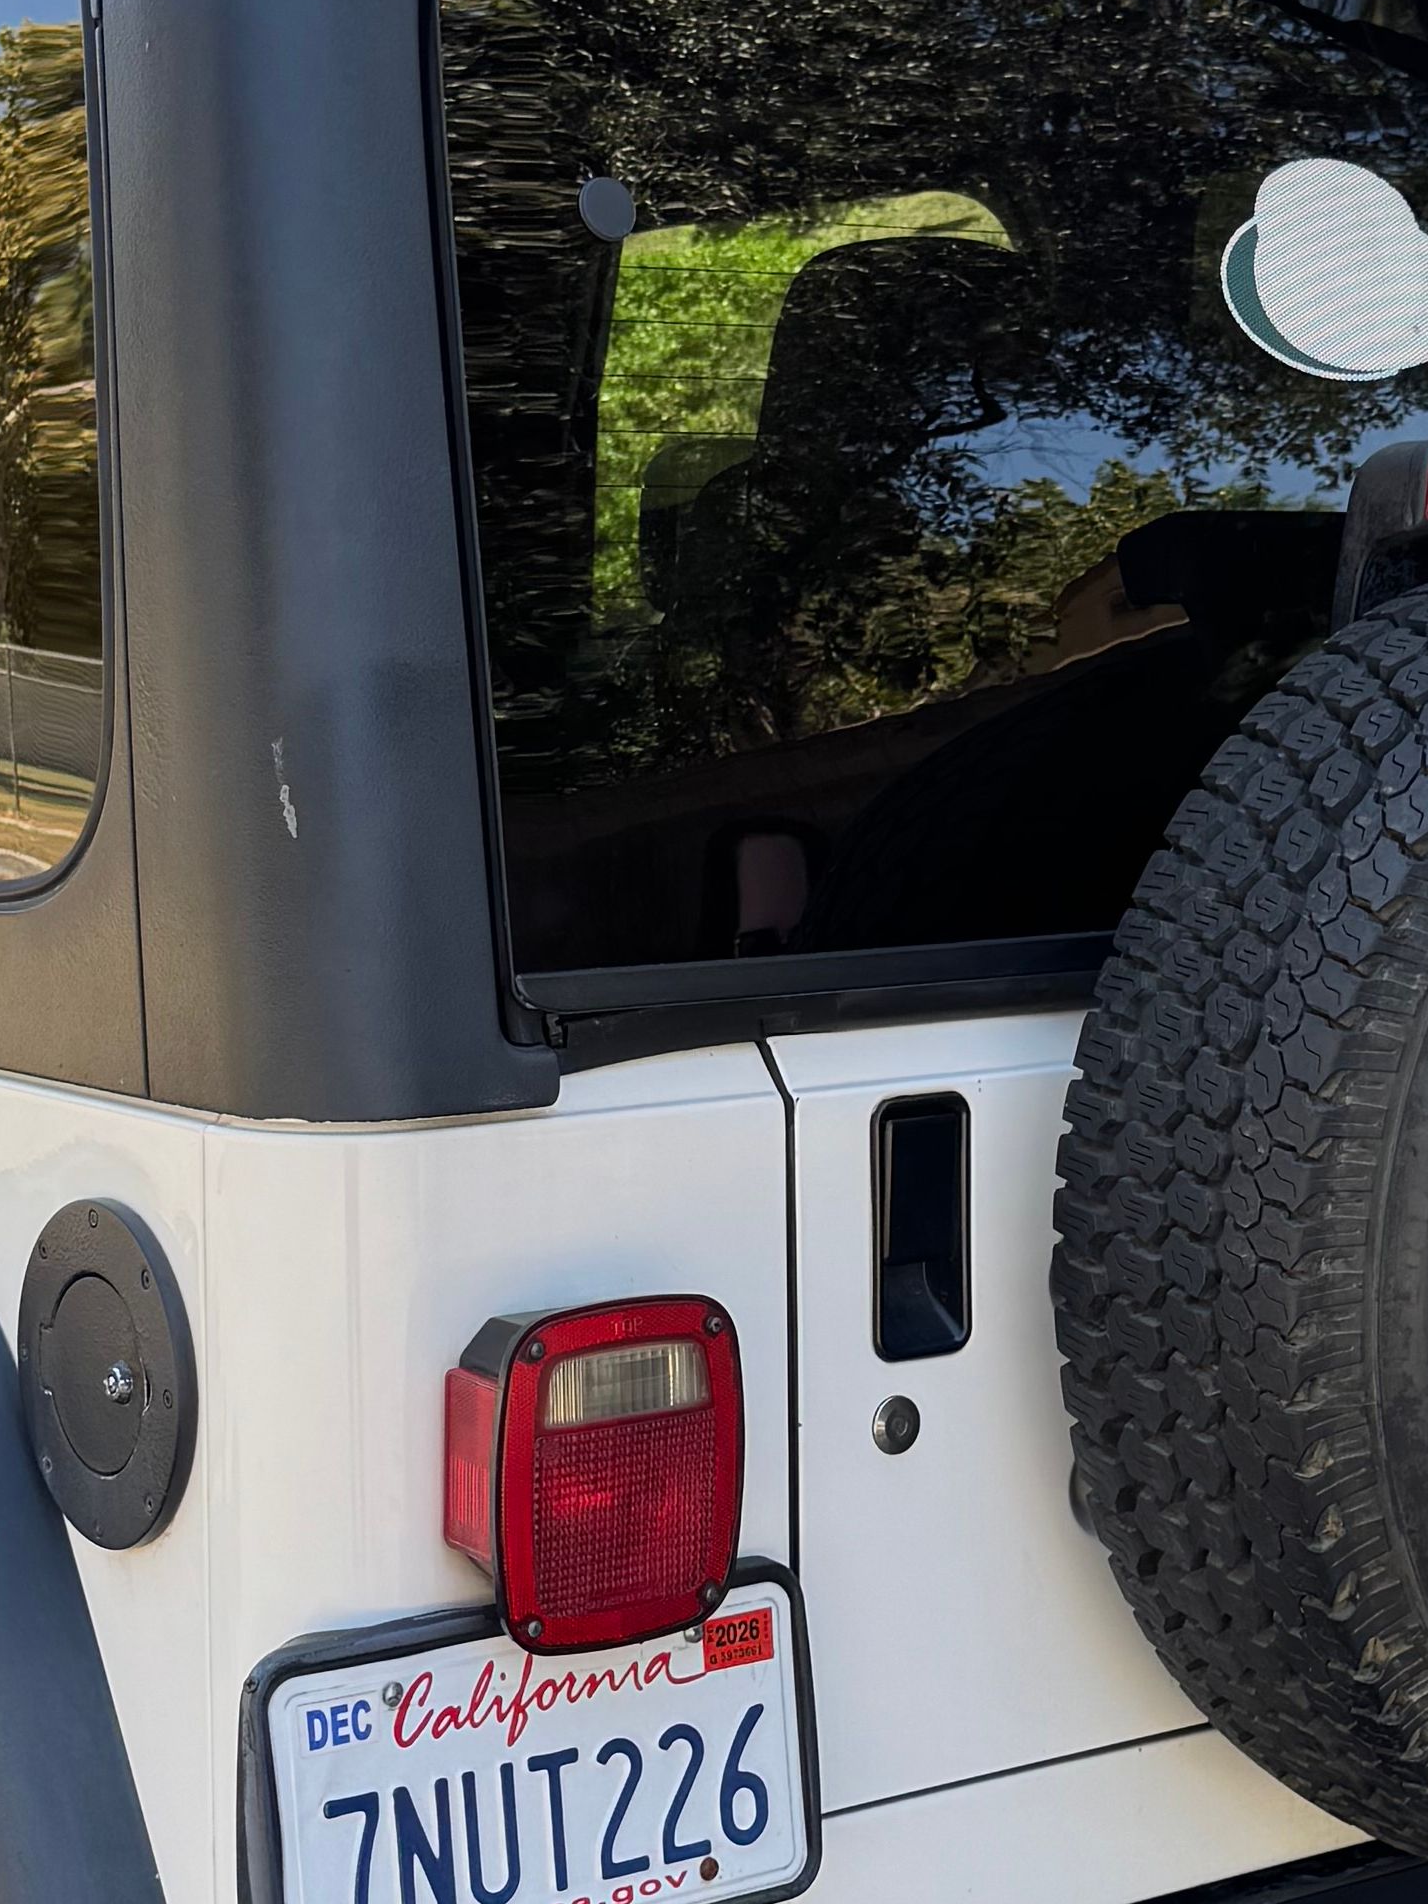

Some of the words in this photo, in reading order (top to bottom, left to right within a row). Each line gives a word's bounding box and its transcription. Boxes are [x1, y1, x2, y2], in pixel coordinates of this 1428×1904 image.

[715, 1618, 760, 1648] 2026
[307, 1699, 372, 1752] DEC
[392, 1651, 708, 1748] California
